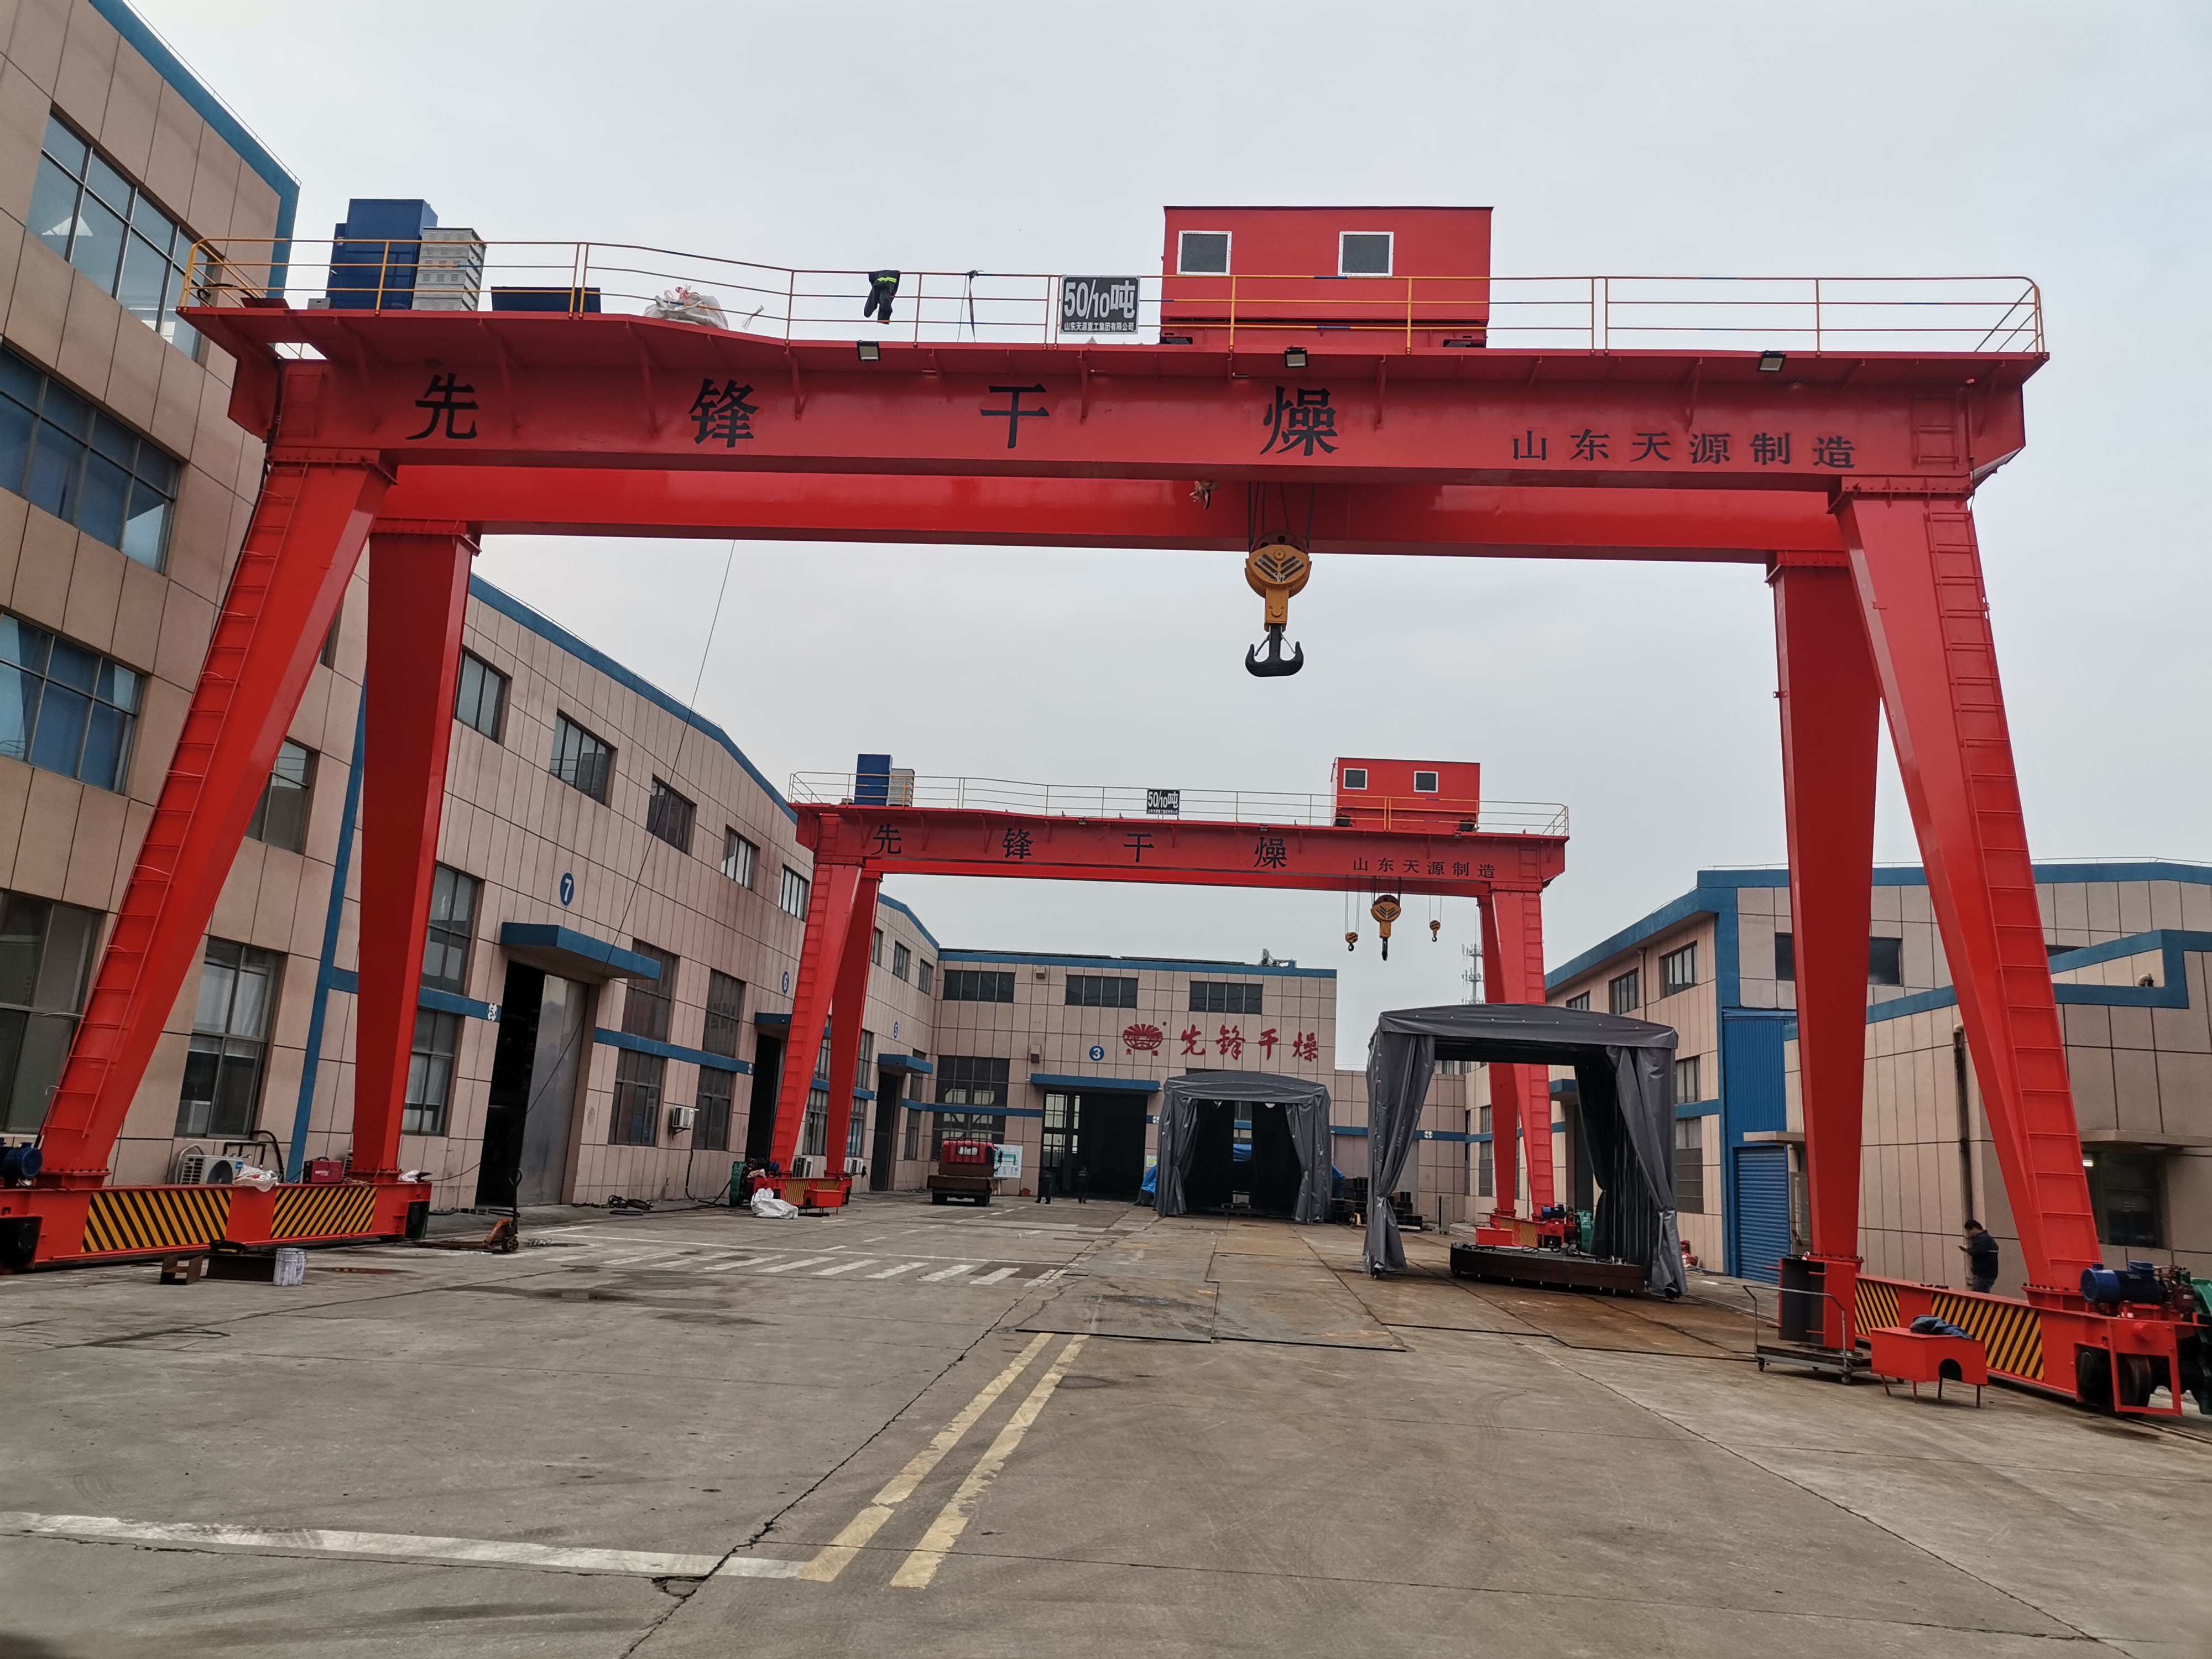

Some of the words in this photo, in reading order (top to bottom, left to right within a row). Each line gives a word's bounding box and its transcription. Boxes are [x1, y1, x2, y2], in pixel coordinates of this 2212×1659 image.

[1064, 279, 1135, 319] 50/10吨
[1064, 322, 1134, 331] 山东天源重工集团有限公司
[405, 373, 1339, 456] 先锋干燥
[1512, 429, 1856, 468] 山东天源制造
[872, 824, 1287, 869] 先锋干燥
[1353, 857, 1496, 879] 山东天源制造
[564, 878, 572, 902] 7
[1093, 1047, 1101, 1059] 3
